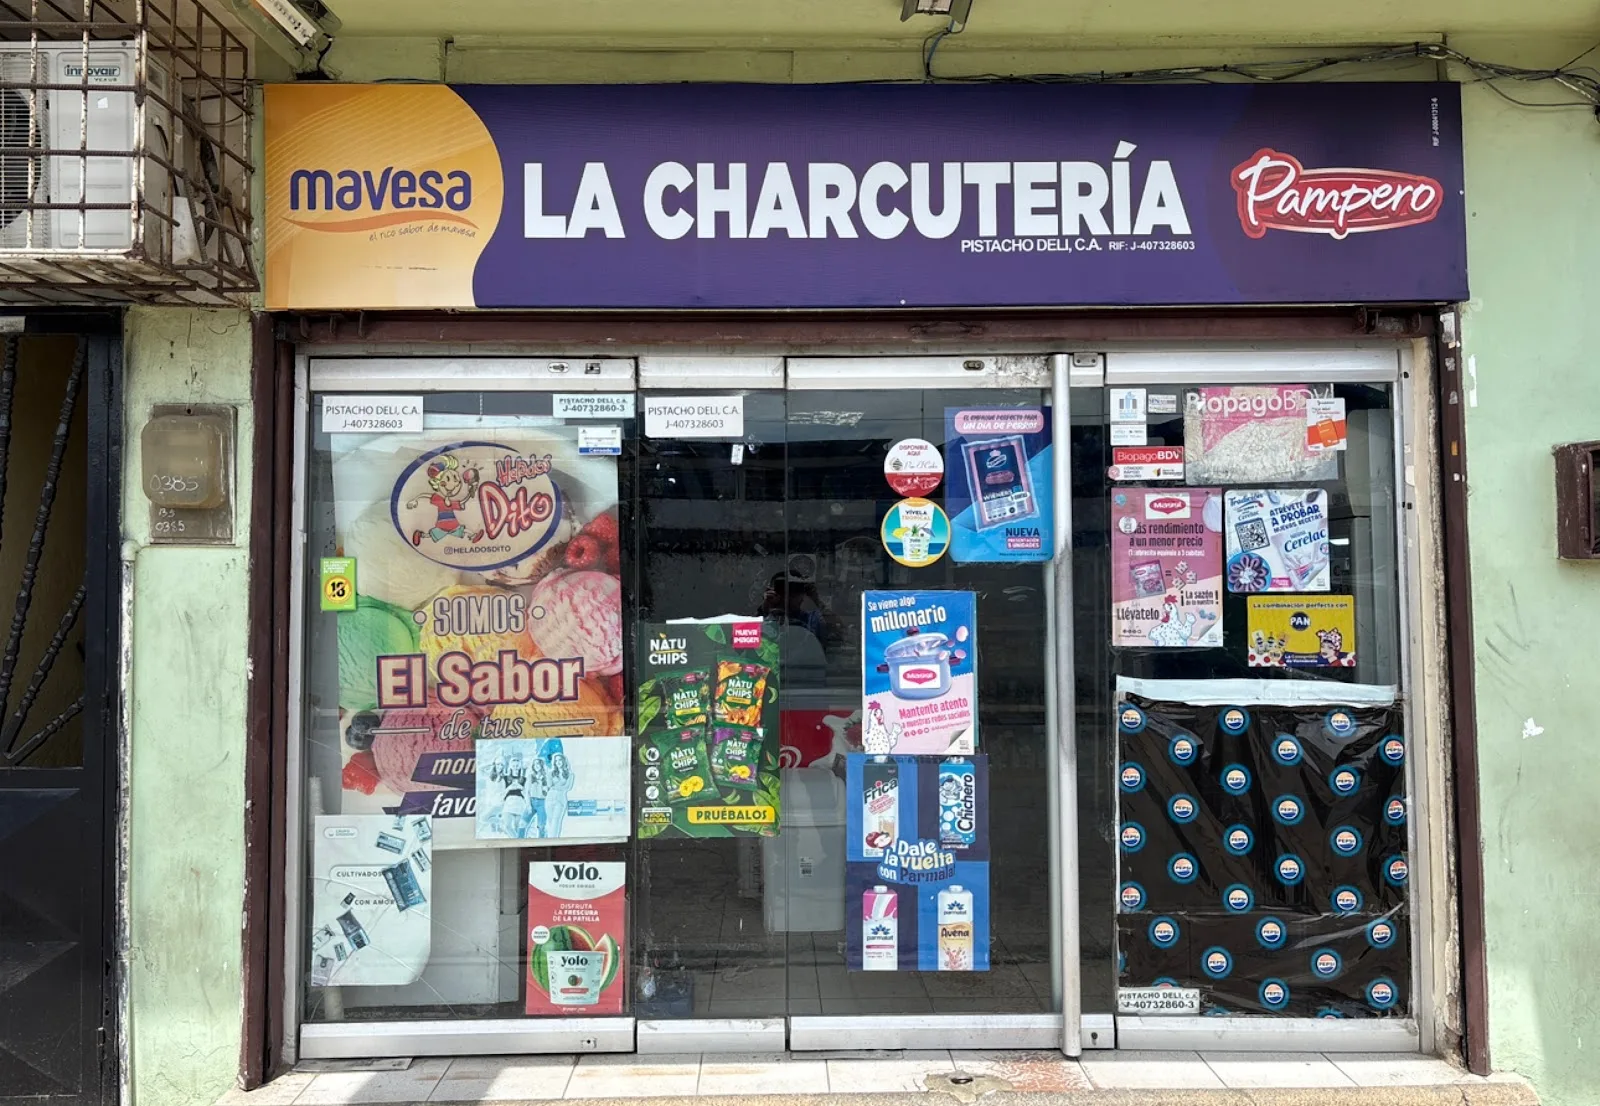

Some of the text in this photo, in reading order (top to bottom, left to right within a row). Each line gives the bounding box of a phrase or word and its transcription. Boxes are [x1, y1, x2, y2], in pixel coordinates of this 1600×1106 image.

[290, 167, 471, 211] mavesa
[524, 140, 1192, 240] LA CHARCUTERÍA
[1239, 155, 1436, 228] Pampero
[369, 222, 477, 242] el rico sabor de mavesa
[961, 238, 1196, 254] PISTACHO DELI, C.A. RIF: J-407328603
[326, 406, 420, 416] PISTACHO DELI, C.A.
[562, 404, 625, 412] J-40732860-3
[648, 406, 740, 416] PISTACHO DELI, C.A.
[342, 420, 403, 428] J-407328603
[666, 420, 724, 429] J-407328603
[963, 422, 976, 430] UN
[992, 422, 1006, 430] DE
[1117, 450, 1180, 462] BiopagoBDV
[496, 454, 552, 487] Helados
[478, 481, 553, 540] Dito
[1269, 501, 1304, 517] ATRÉVETE
[1272, 504, 1320, 528] A PROBAR
[1298, 513, 1324, 526] RECETAS
[1006, 528, 1040, 536] NUEVA
[1149, 522, 1204, 534] rendimiento
[1130, 536, 1203, 548] a un menor precio
[1284, 528, 1327, 553] Cerelac
[453, 546, 512, 555] HELADOSDITO
[330, 581, 346, 598] 18
[1194, 589, 1214, 599] sazón
[868, 596, 916, 612] Se viene algo
[432, 594, 526, 637] SOMOS
[870, 604, 947, 633] millonario
[1116, 607, 1160, 621] Llévatelo
[648, 652, 688, 666] CHIPS
[376, 650, 585, 709] El Sabor
[726, 688, 752, 698] CHIPS
[674, 698, 700, 710] CHIPS
[899, 698, 968, 720] Mantente atento
[438, 709, 525, 740] de tus
[931, 714, 948, 722] redes
[725, 748, 747, 757] CHIPS
[672, 756, 698, 769] CHIPS
[864, 778, 898, 805] Frica
[956, 774, 974, 832] Chichero
[696, 808, 768, 820] PRUÉBALOS
[898, 840, 936, 857] Dale
[884, 848, 954, 871] la vuelta
[552, 862, 603, 883] yolo.
[880, 866, 897, 880] con
[940, 928, 970, 938] Avena
[1162, 992, 1184, 1000] DELI,
[1122, 1000, 1194, 1008] J-40732860-3
